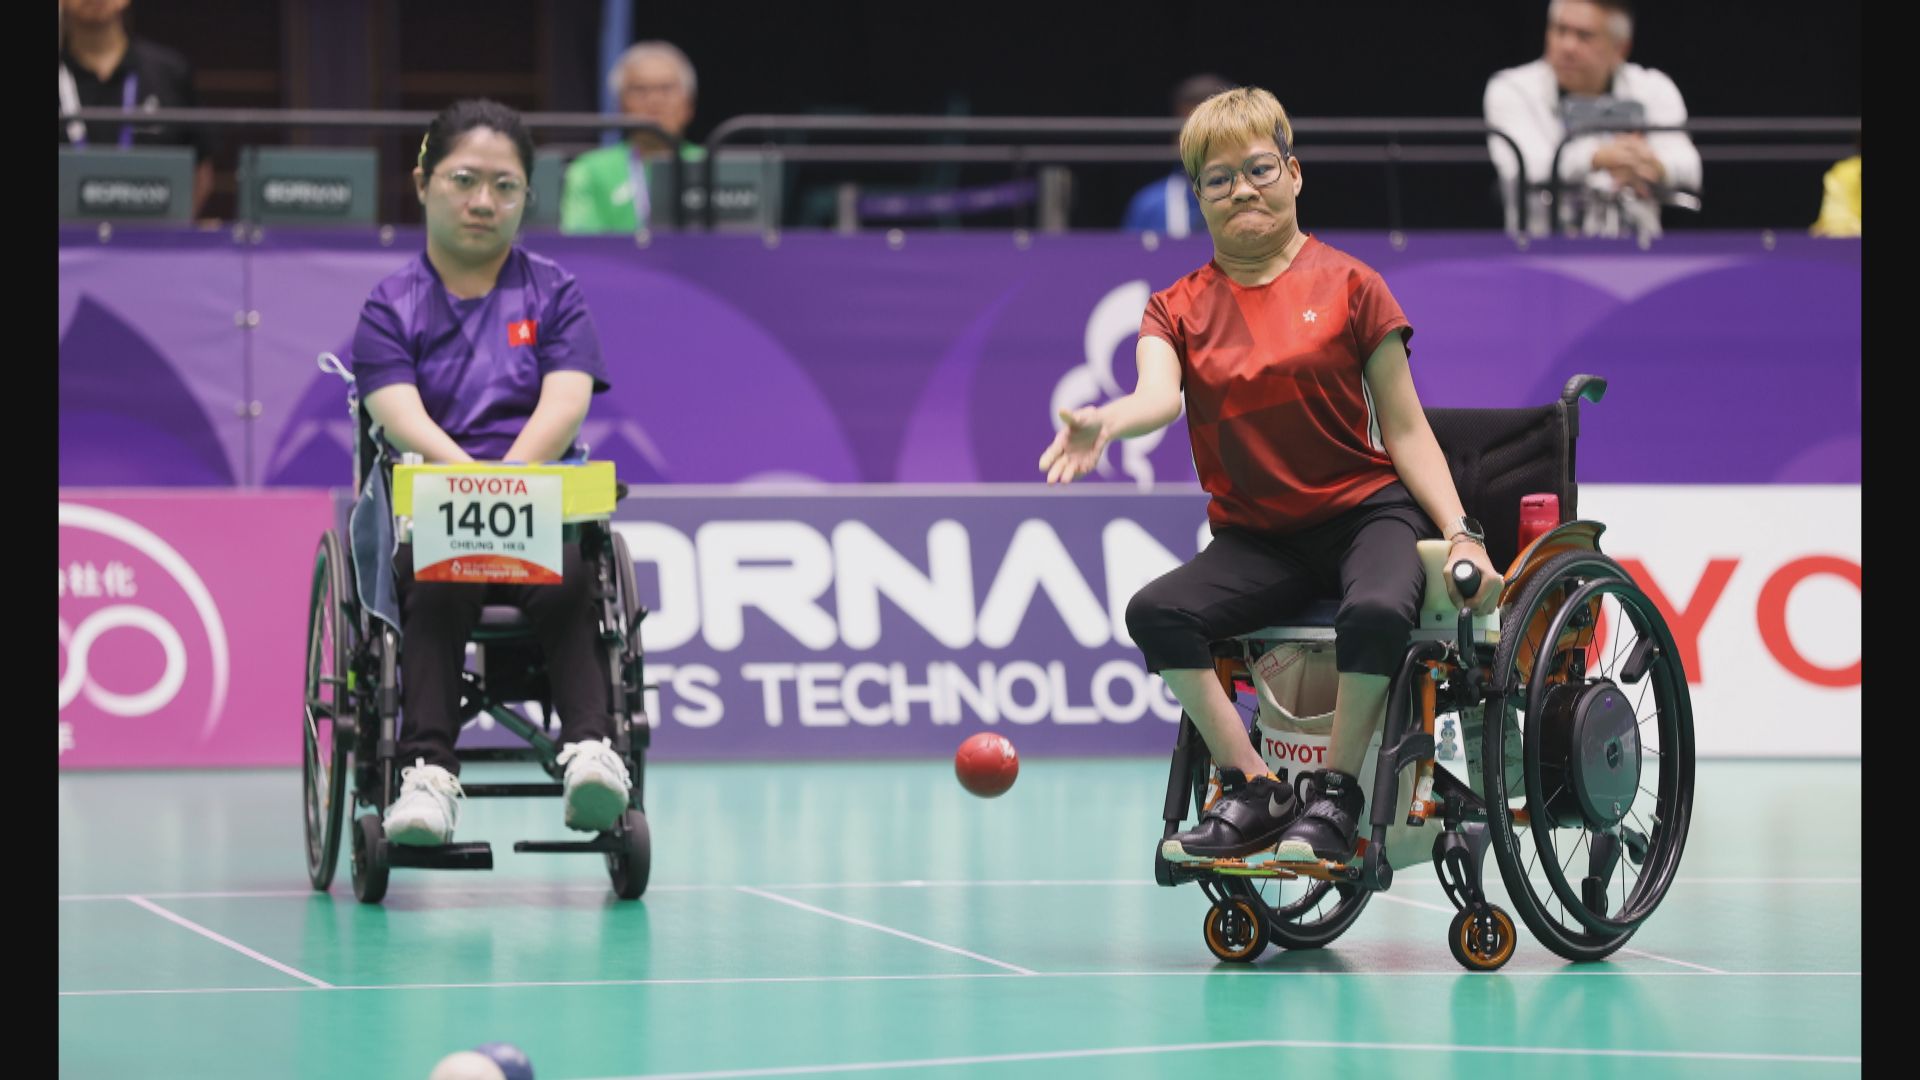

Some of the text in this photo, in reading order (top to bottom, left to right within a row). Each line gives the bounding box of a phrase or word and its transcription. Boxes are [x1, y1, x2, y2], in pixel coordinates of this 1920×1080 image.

[446, 477, 528, 495] TOYOTA
[438, 501, 534, 539] 1401
[450, 541, 525, 550] CHEUNG HKG
[1266, 738, 1327, 764] TOYOT
